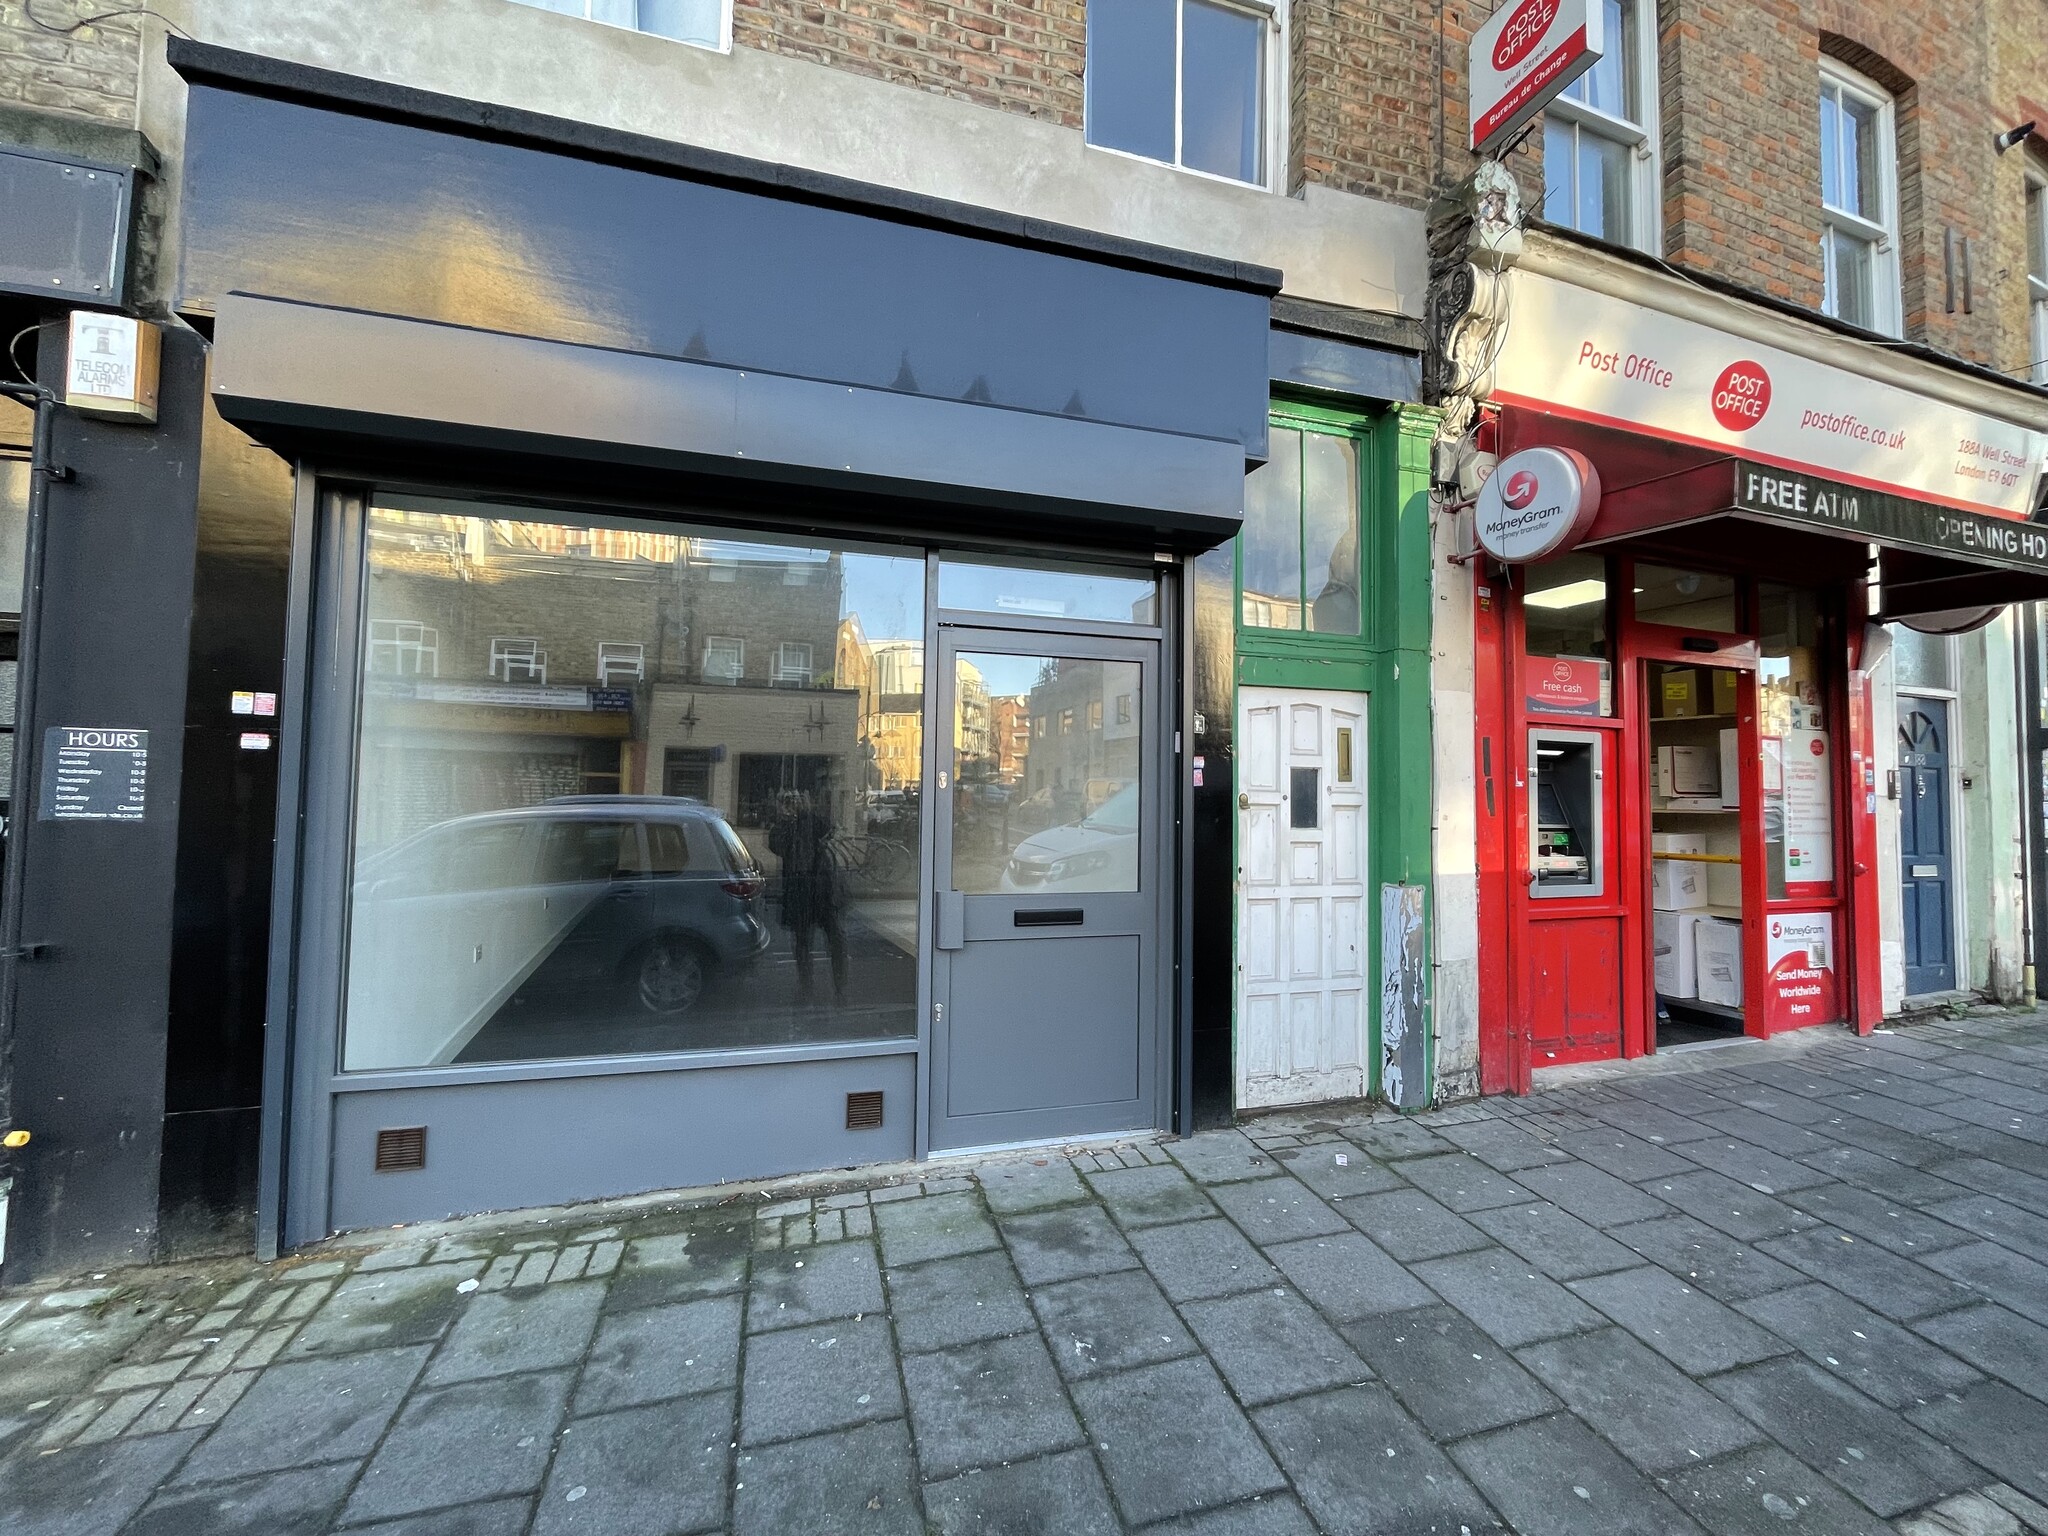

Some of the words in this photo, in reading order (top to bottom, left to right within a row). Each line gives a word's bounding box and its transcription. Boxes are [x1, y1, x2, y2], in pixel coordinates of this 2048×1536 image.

[1498, 3, 1553, 65] OFFICE
[1507, 0, 1543, 42] POST
[1504, 69, 1522, 89] Well
[1523, 45, 1549, 72] Street
[1489, 96, 1519, 126] Bureau
[1520, 83, 1532, 97] de
[1534, 51, 1568, 85] Change
[1578, 341, 1620, 374] Post
[1624, 354, 1673, 388] Office
[77, 371, 126, 387] ALARMS
[1728, 372, 1764, 397] POST
[1715, 390, 1763, 418] OFFICE
[1800, 408, 1907, 451] postoffice.co.uk
[1957, 439, 1981, 456] 188A
[1982, 445, 2000, 462] Well
[2000, 450, 2028, 469] Street
[1954, 459, 1986, 480] London
[1987, 468, 2000, 483] E9
[1747, 473, 1808, 513] FREE
[1813, 490, 1859, 522] ATM
[1485, 505, 1560, 535] MoneyGram
[1495, 529, 1520, 541] money
[1520, 521, 1550, 535] transfer
[1936, 516, 2018, 553] OPENING
[1543, 680, 1561, 691] Free
[1563, 683, 1582, 694] cash
[68, 731, 139, 748] HOURS
[1783, 925, 1824, 937] MoneyGram
[1776, 969, 1797, 981] Send
[1797, 968, 1823, 980] Money
[1779, 984, 1822, 998] Worldwide
[1791, 1003, 1811, 1014] Here
